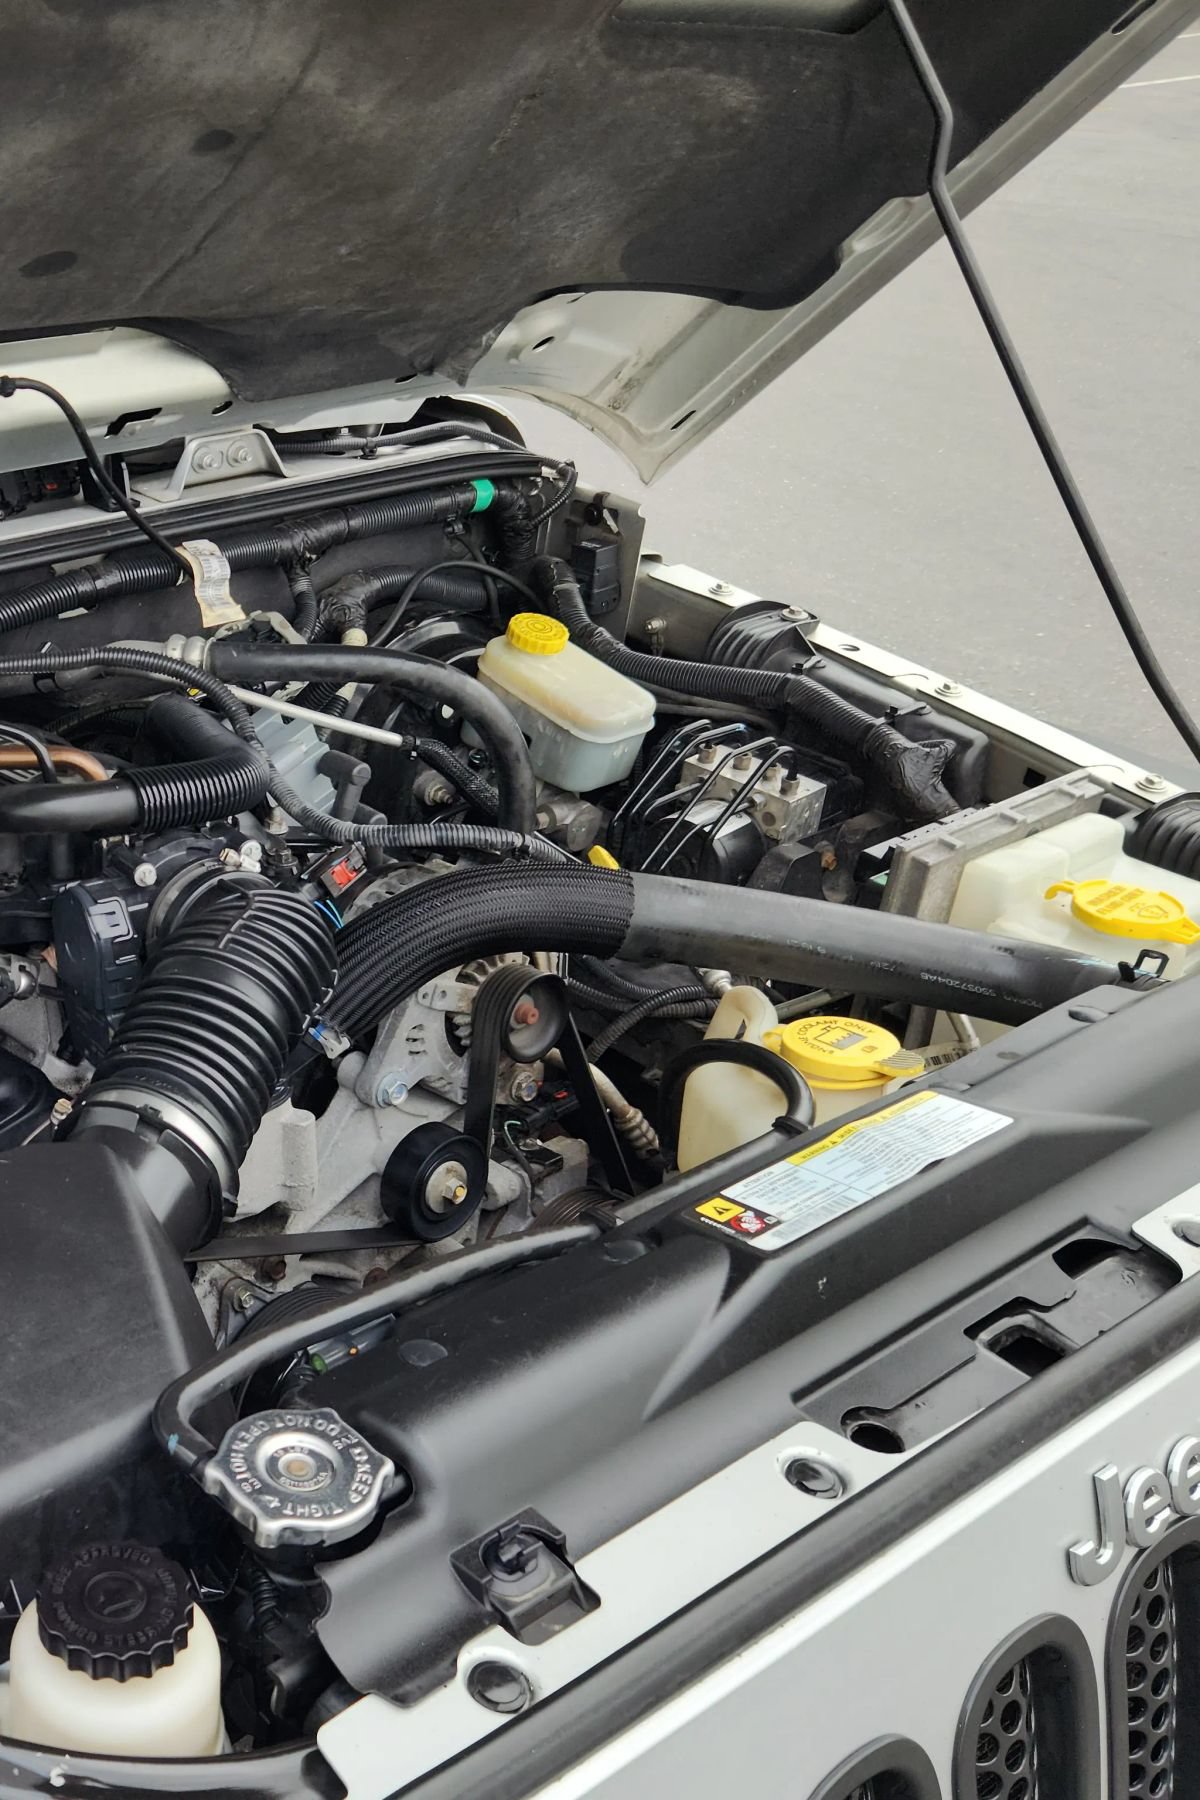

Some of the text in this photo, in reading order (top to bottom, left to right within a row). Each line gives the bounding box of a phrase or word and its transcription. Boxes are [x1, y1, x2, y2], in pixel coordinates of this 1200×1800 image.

[797, 1020, 838, 1036] COOLANT
[844, 1021, 875, 1034] ONLY
[274, 1414, 313, 1430] NOT
[314, 1418, 341, 1438] DO
[230, 1419, 271, 1452] OPEN
[230, 1451, 252, 1481] HOT
[348, 1462, 373, 1505] KEEP
[282, 1501, 345, 1518] TIGHT
[74, 1544, 152, 1569] APPROVED
